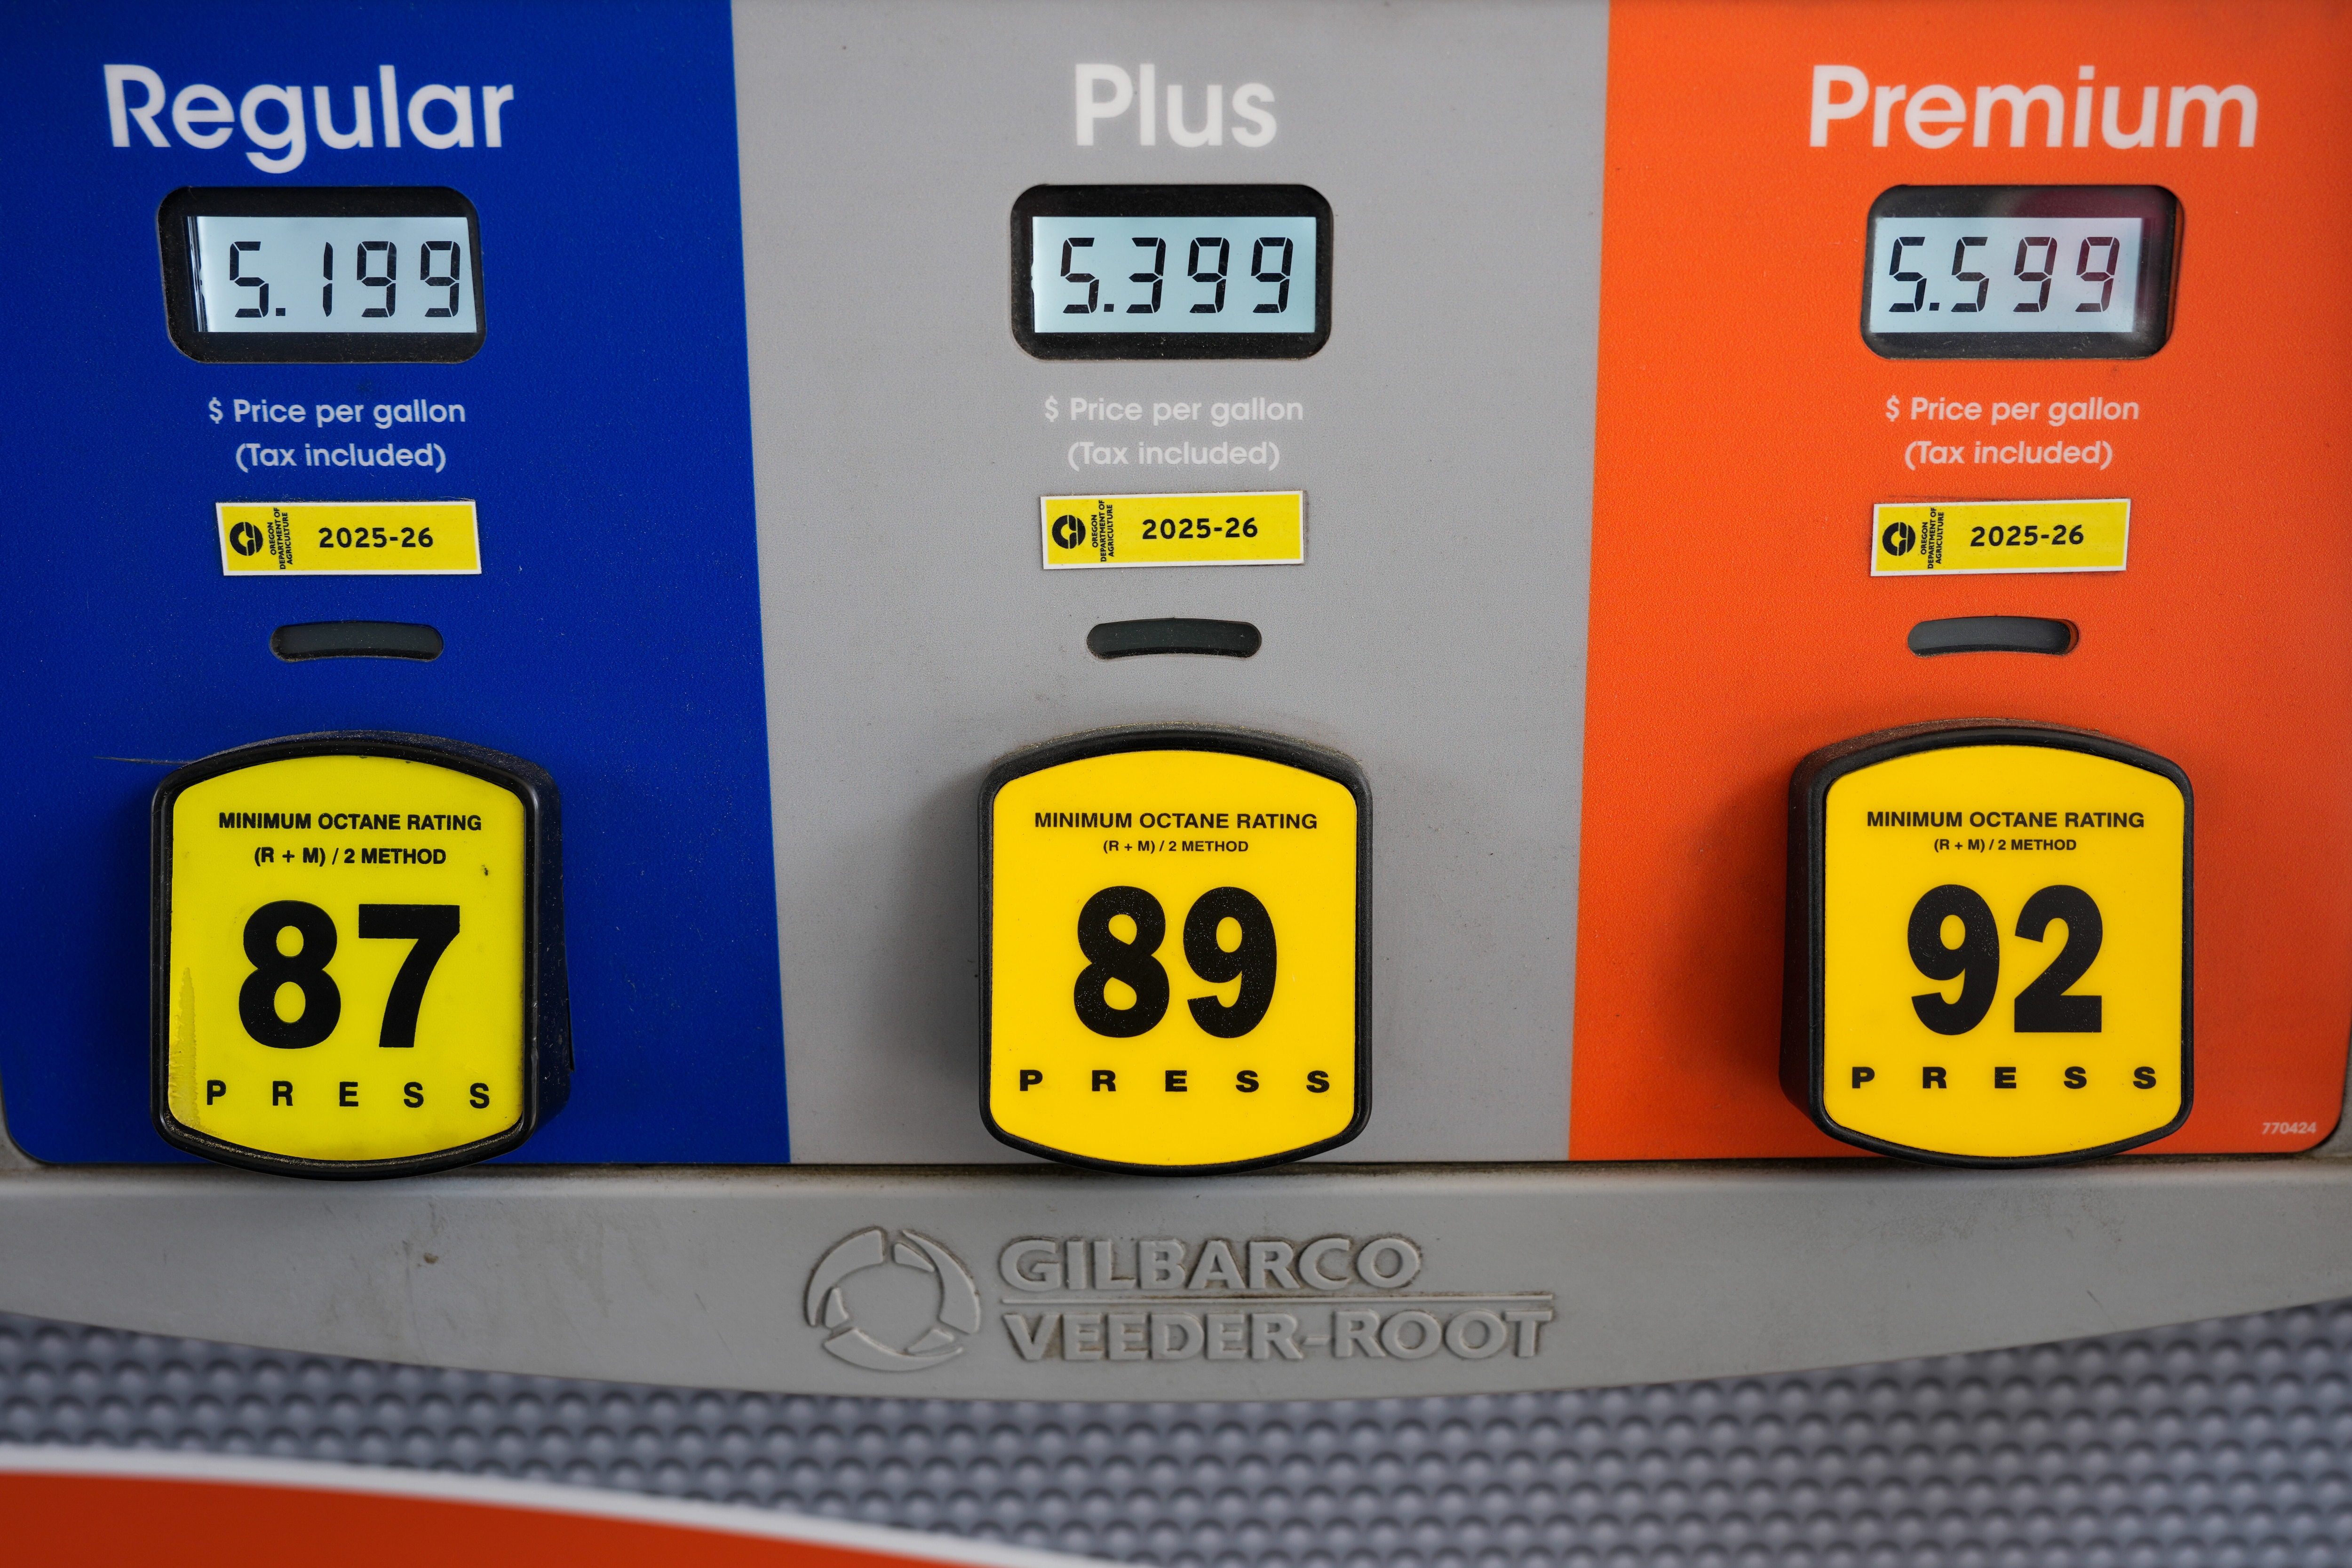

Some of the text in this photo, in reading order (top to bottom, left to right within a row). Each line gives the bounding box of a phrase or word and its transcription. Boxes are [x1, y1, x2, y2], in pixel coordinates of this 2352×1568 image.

[103, 63, 515, 174] Regular
[1074, 63, 1278, 148] Plus
[1809, 64, 2258, 149] Premium
[229, 240, 461, 318] 5.199
[1060, 237, 1294, 314] 5.399
[1887, 236, 2120, 313] 5.599
[209, 397, 466, 429] $ Price per gallon
[1045, 396, 1304, 427] $ Price per gallon
[1885, 395, 2139, 426] $ Price per gallon
[236, 443, 446, 473] (Tax included)
[1067, 441, 1280, 471] (Tax included)
[1905, 440, 2113, 470] (Tax included)
[1099, 500, 1105, 509] OF
[1931, 507, 1937, 517] OF
[267, 522, 277, 555] OREGON
[274, 507, 286, 569] DEPARTMENT OF
[282, 512, 293, 565] AGRICULTURE
[318, 526, 434, 548] 2025-26
[1142, 517, 1258, 540] 2025-26
[1970, 525, 2084, 547] 2025-26
[219, 812, 482, 831] MINIMUM OCTANE RATING
[1035, 812, 1318, 829] MINIMUM OCTANE RATING
[1867, 811, 2145, 828] MINIMUM OCTANE RATING
[254, 846, 446, 867] (R + M) / 2 METHOD
[1103, 840, 1249, 854] (R + M) / 2 METHOD
[1933, 838, 2077, 853] (R + M) / 2 METHOD
[1073, 885, 1277, 1039] 89
[1907, 883, 2103, 1035] 92
[238, 900, 461, 1050] 87
[2262, 1122, 2317, 1134] 770424
[999, 1234, 1422, 1291] GILBARCO
[1001, 1308, 1556, 1362] VEEDER-ROOT
